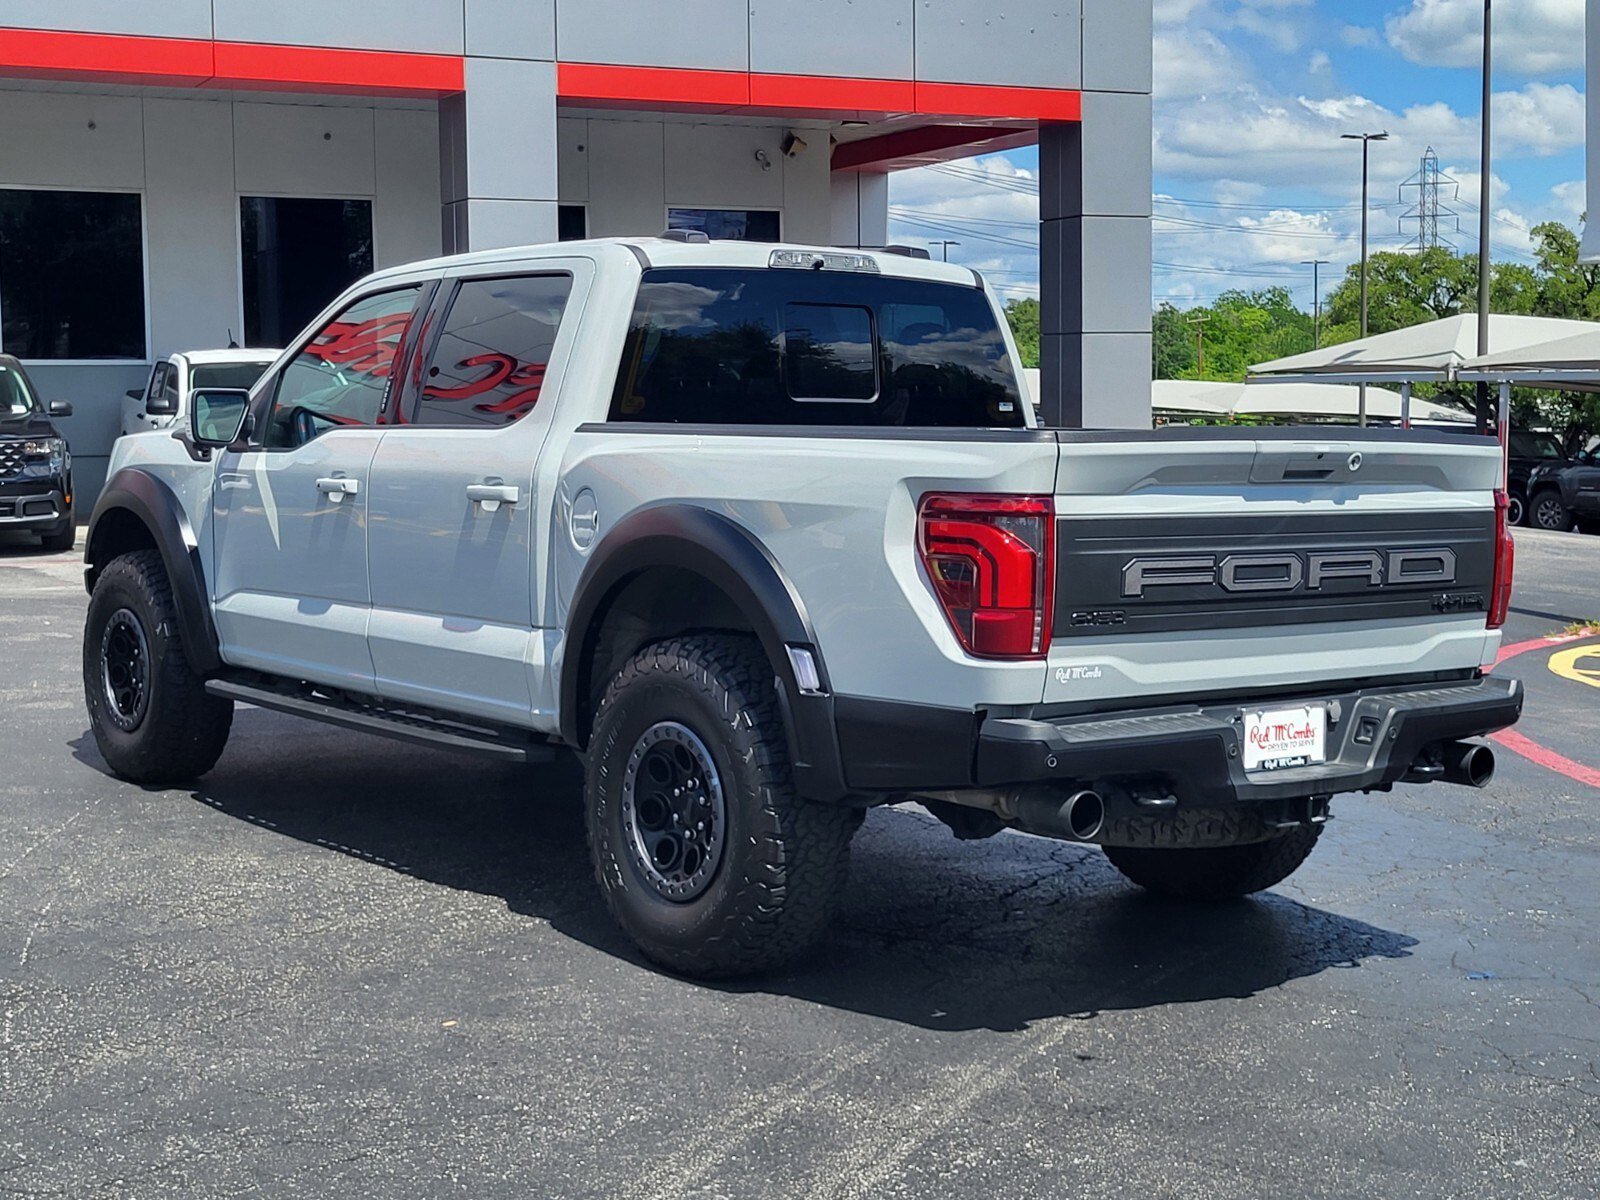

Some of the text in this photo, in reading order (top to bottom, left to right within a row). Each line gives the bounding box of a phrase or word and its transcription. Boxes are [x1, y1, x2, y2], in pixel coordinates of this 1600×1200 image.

[1121, 548, 1457, 598] FORD
[1055, 667, 1071, 684] Red
[1250, 722, 1315, 749] Red McCombs
[1268, 739, 1315, 750] DRIVEN TO SERVE
